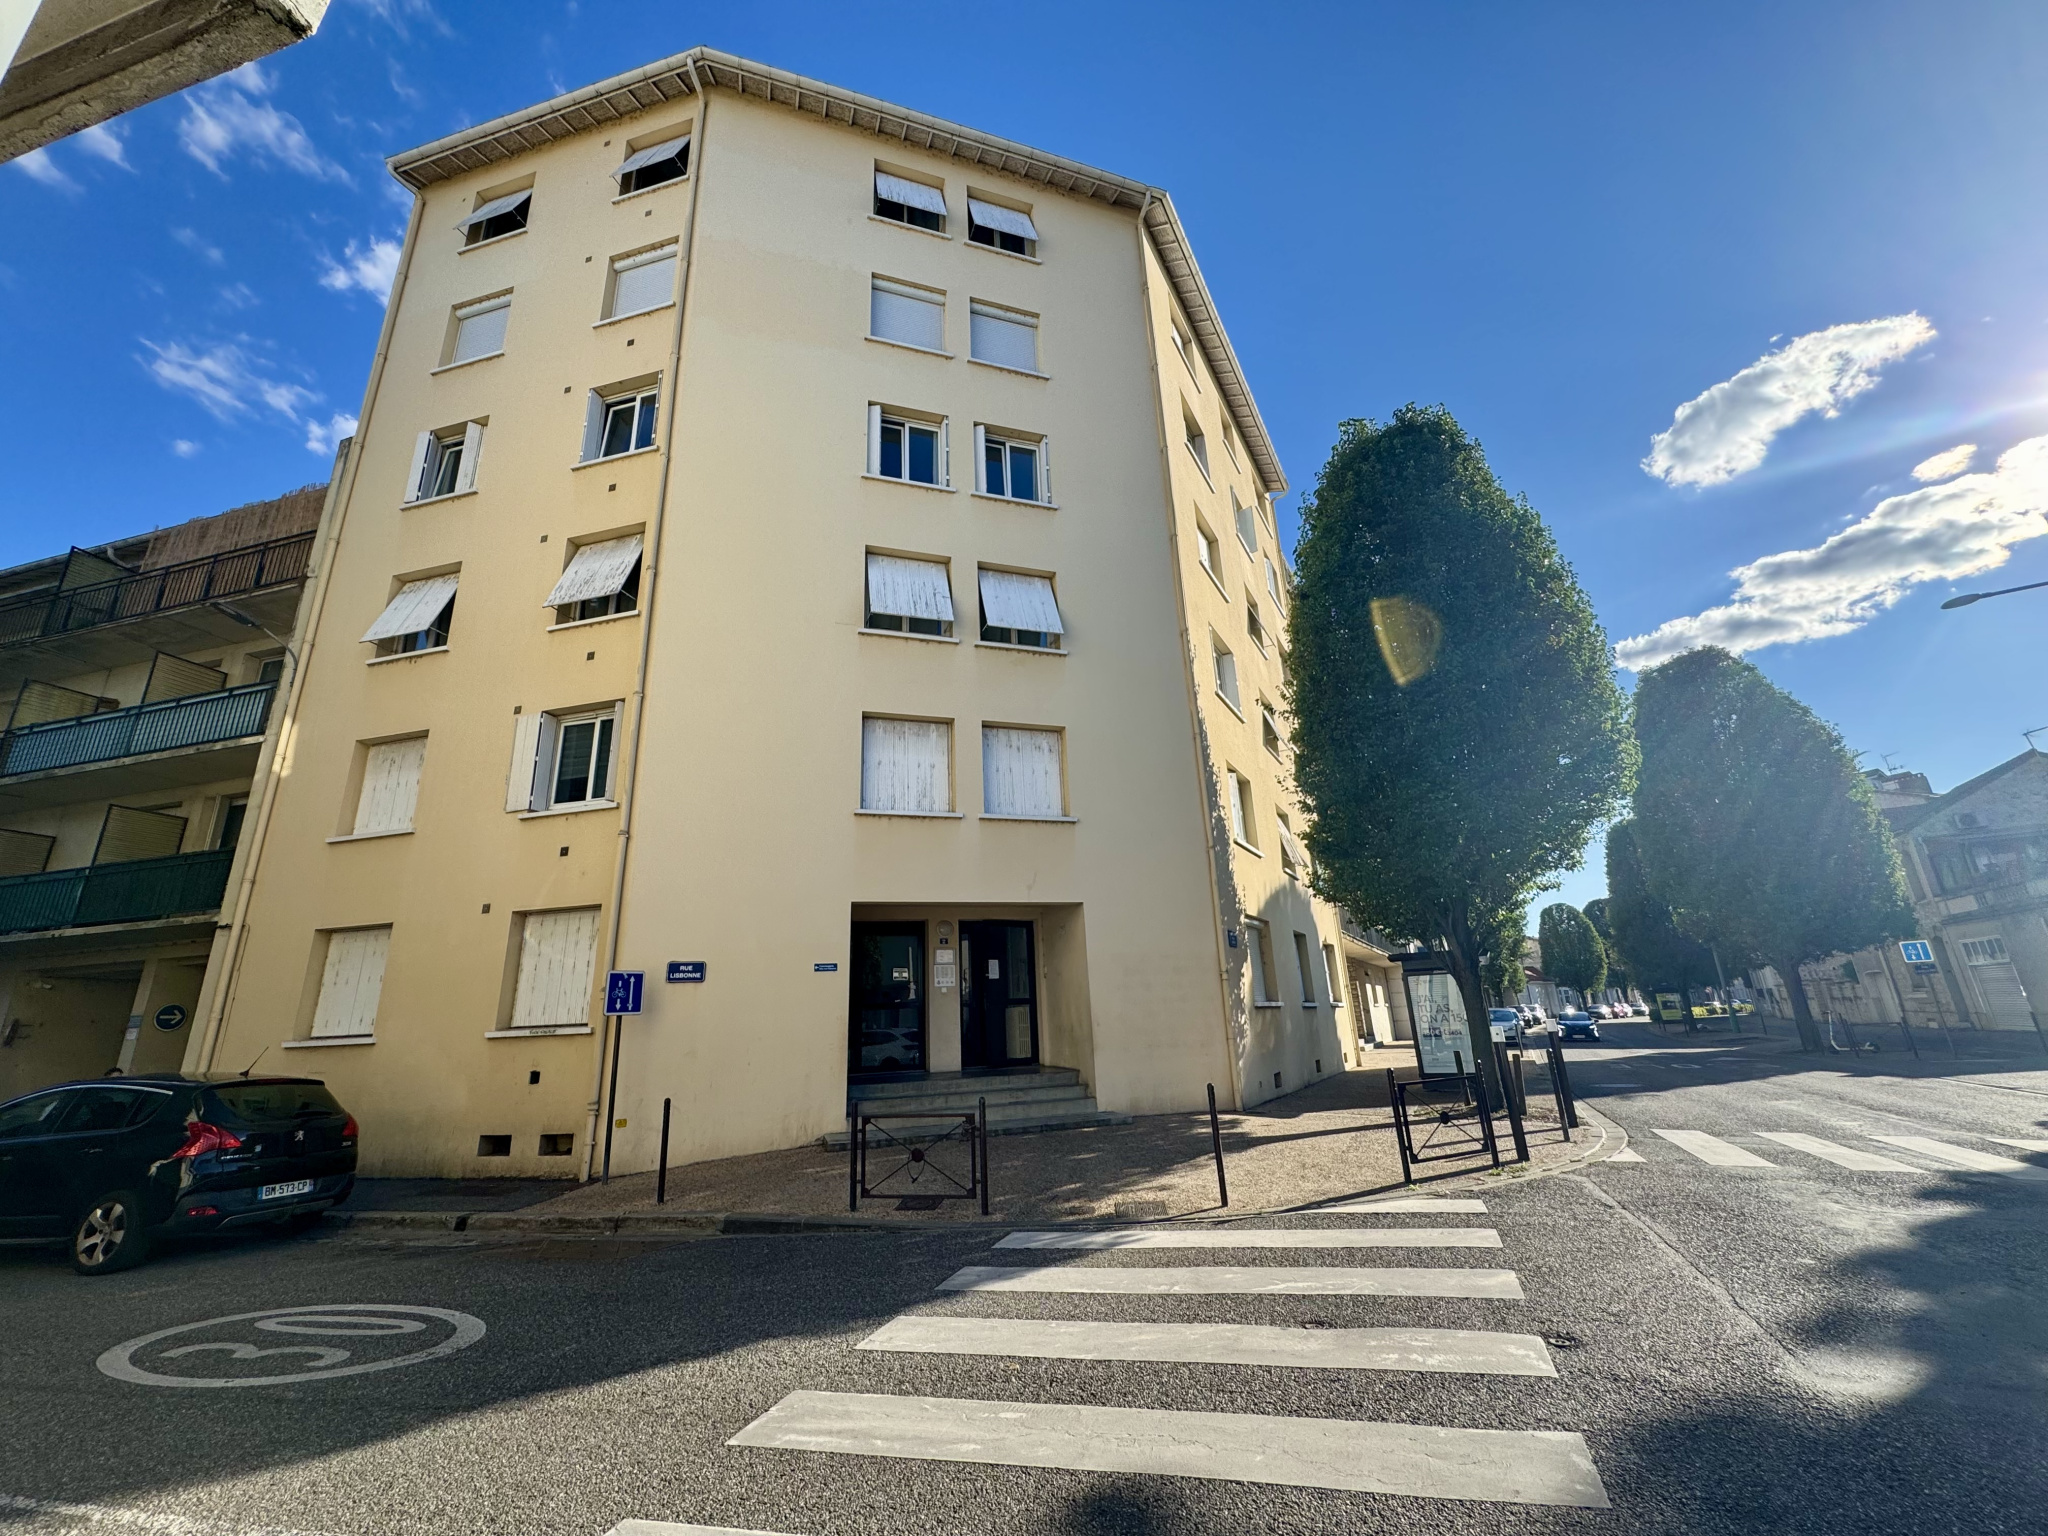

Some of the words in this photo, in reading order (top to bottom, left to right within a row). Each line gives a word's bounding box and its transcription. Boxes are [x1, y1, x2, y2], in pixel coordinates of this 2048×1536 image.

[1418, 1004, 1433, 1013] TU
[1420, 1013, 1438, 1024] ON
[1441, 1013, 1450, 1023] A
[264, 1181, 308, 1197] BM-573-CP
